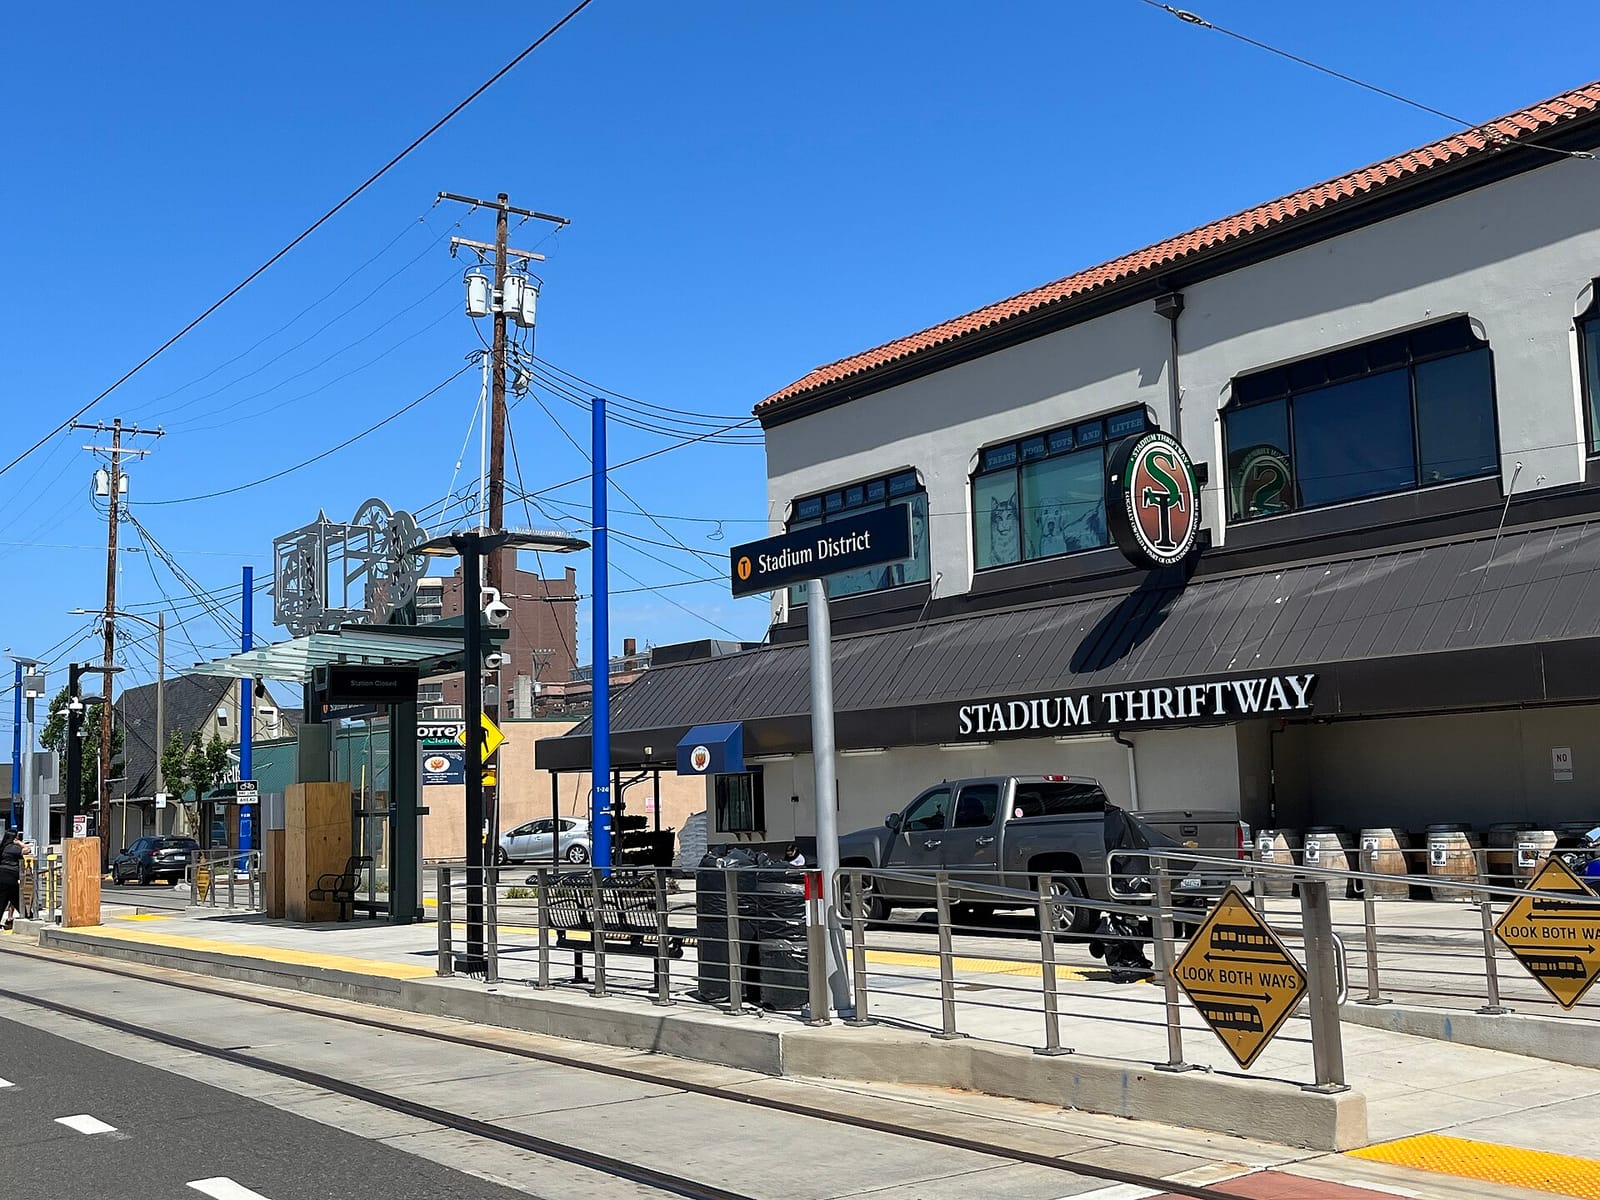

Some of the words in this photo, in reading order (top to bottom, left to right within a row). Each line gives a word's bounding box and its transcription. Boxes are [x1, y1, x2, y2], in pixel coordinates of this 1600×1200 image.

[987, 453, 1017, 465] TREATS
[1023, 444, 1045, 457] FOOD
[1051, 436, 1073, 449] TOYS
[1082, 429, 1100, 441] AND
[1111, 417, 1143, 433] LITTER
[1130, 434, 1155, 458] STADIUM
[1156, 434, 1190, 463] THRIFTWAY
[758, 549, 812, 574] Stadium
[817, 530, 871, 560] District
[375, 680, 397, 688] Closed
[959, 695, 1091, 735] STADIUM
[1102, 674, 1315, 724] THRIFTWAY
[1557, 753, 1567, 762] NO
[1504, 926, 1538, 938] LOOK
[1542, 926, 1576, 939] BOTH
[1182, 966, 1215, 982] LOOK
[1219, 969, 1253, 985] BOTH
[1258, 973, 1297, 989] WAYS
